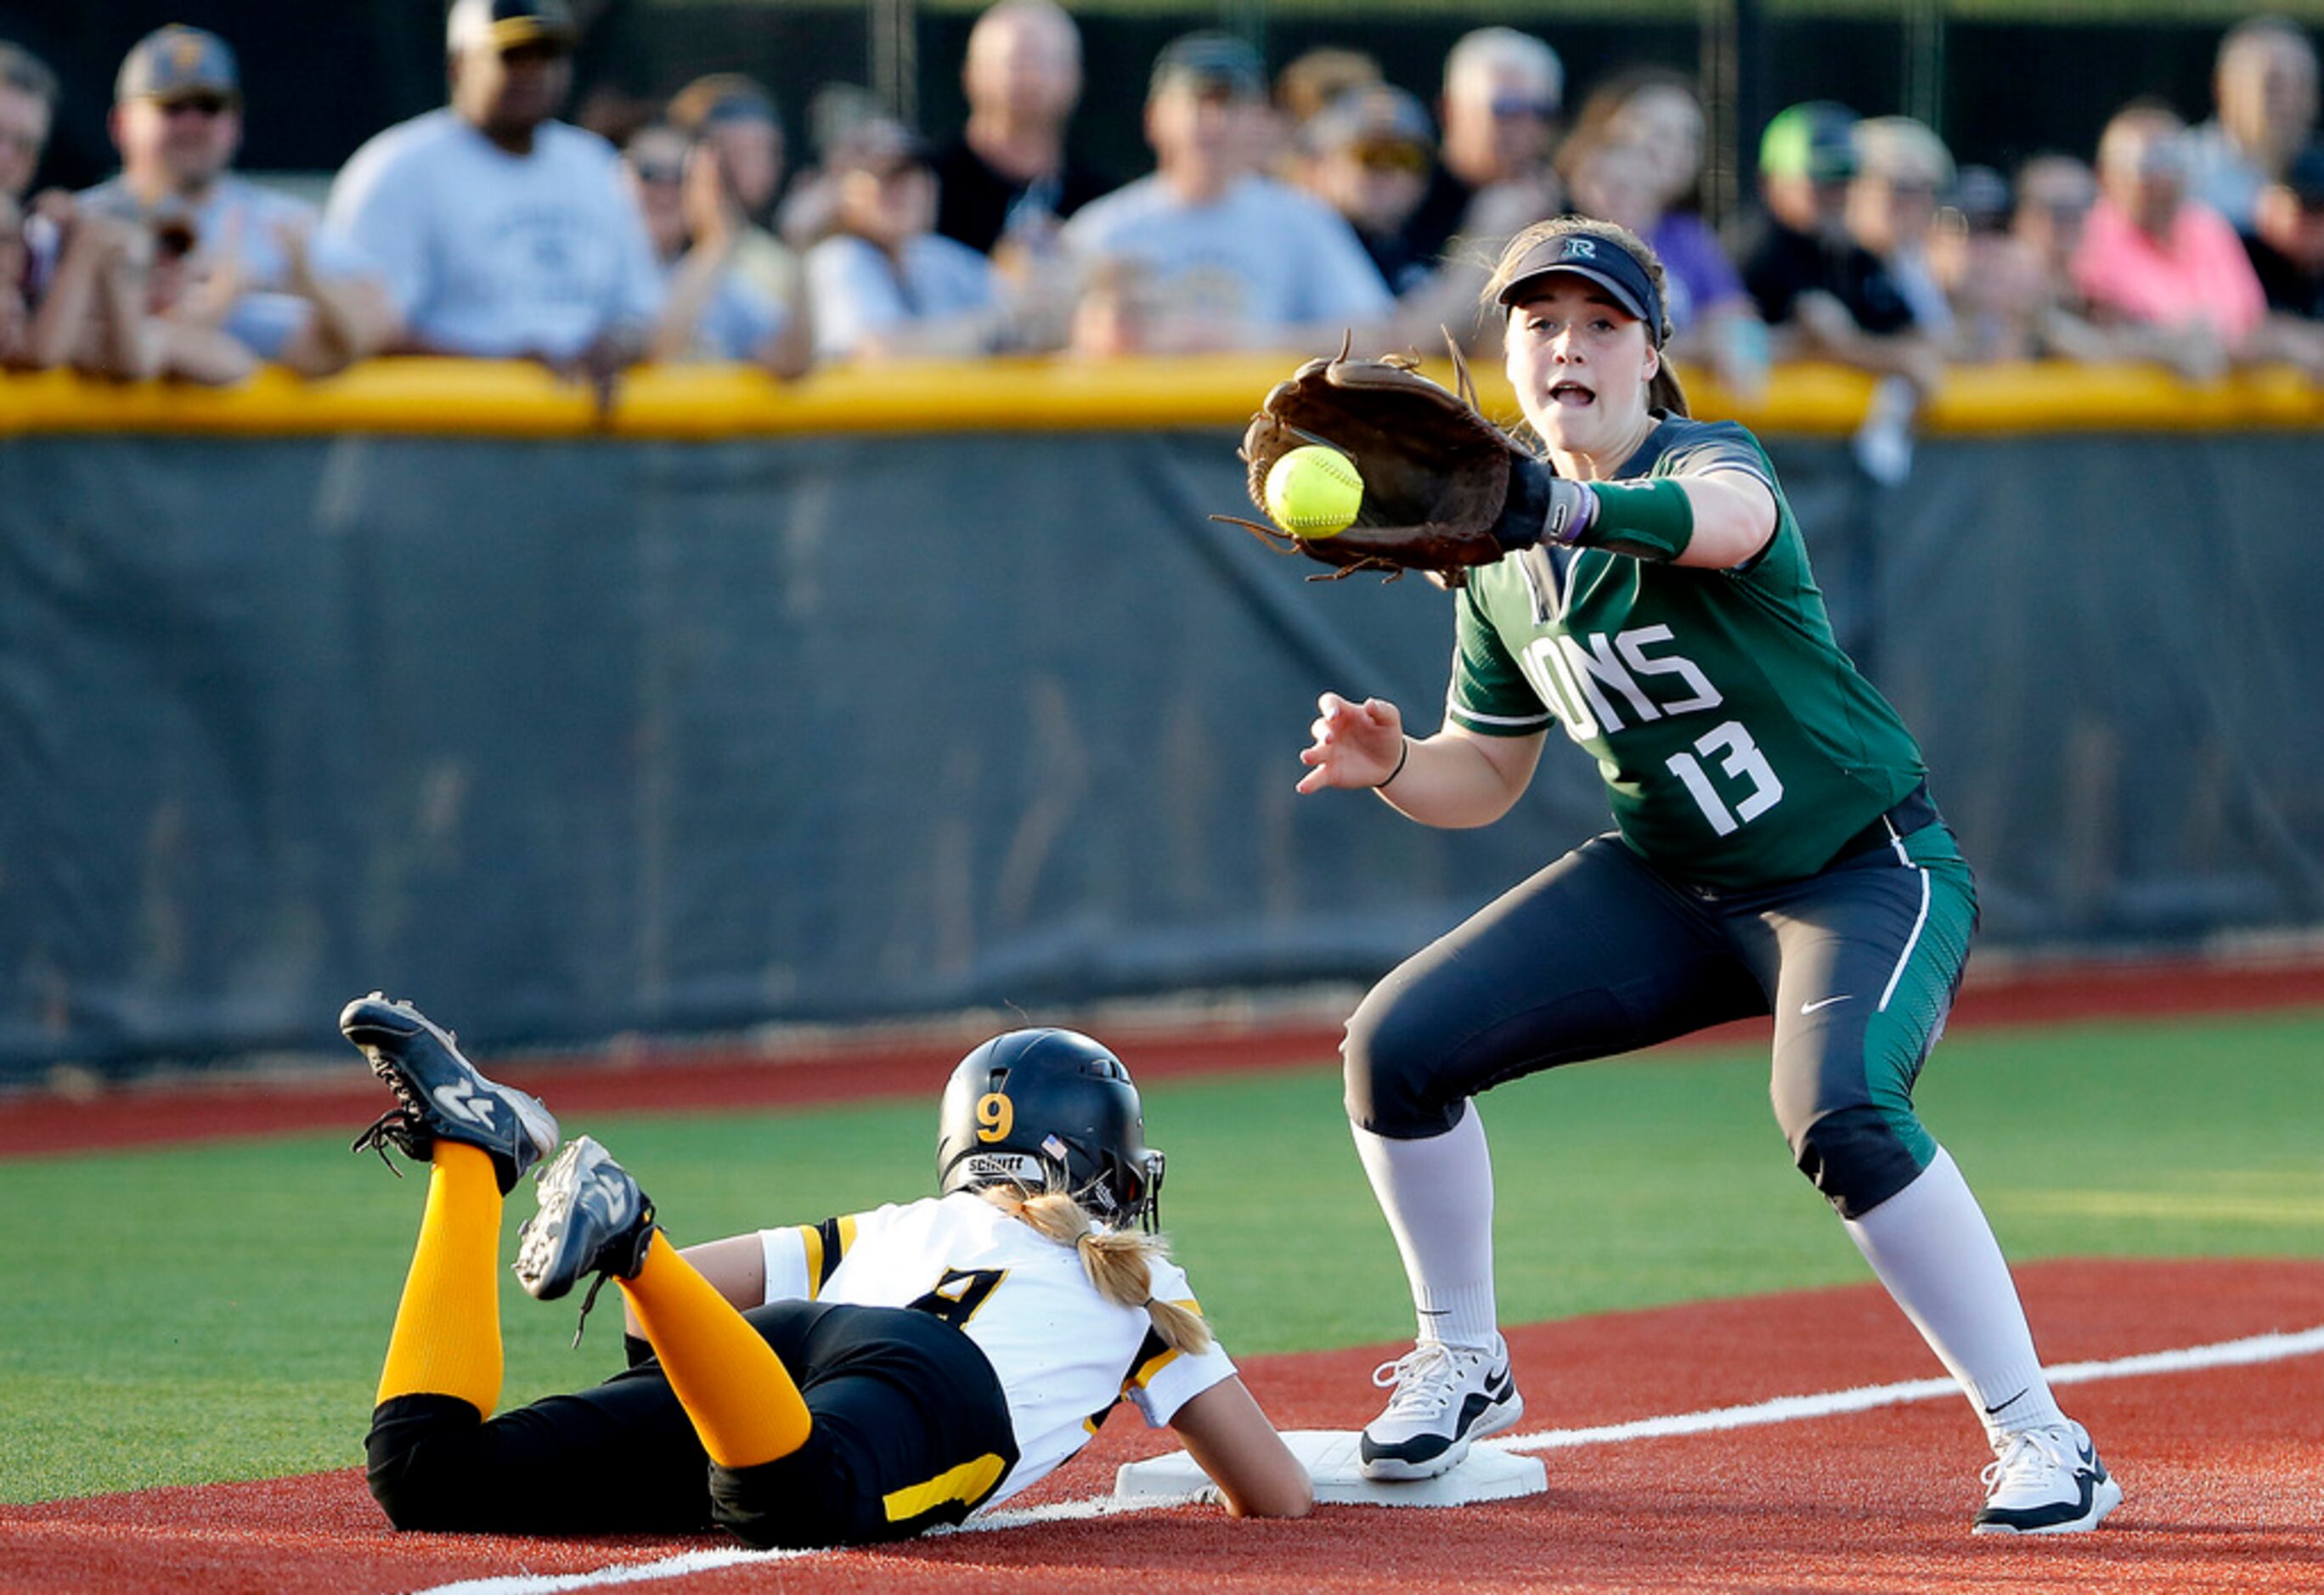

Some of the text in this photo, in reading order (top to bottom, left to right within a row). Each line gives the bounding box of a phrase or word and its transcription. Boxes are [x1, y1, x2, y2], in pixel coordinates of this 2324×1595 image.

[1562, 238, 1596, 258] R
[1520, 624, 1723, 741] IONS
[1665, 720, 1784, 837] 13
[977, 1093, 1014, 1142] 9
[969, 1153, 1024, 1171] schutt
